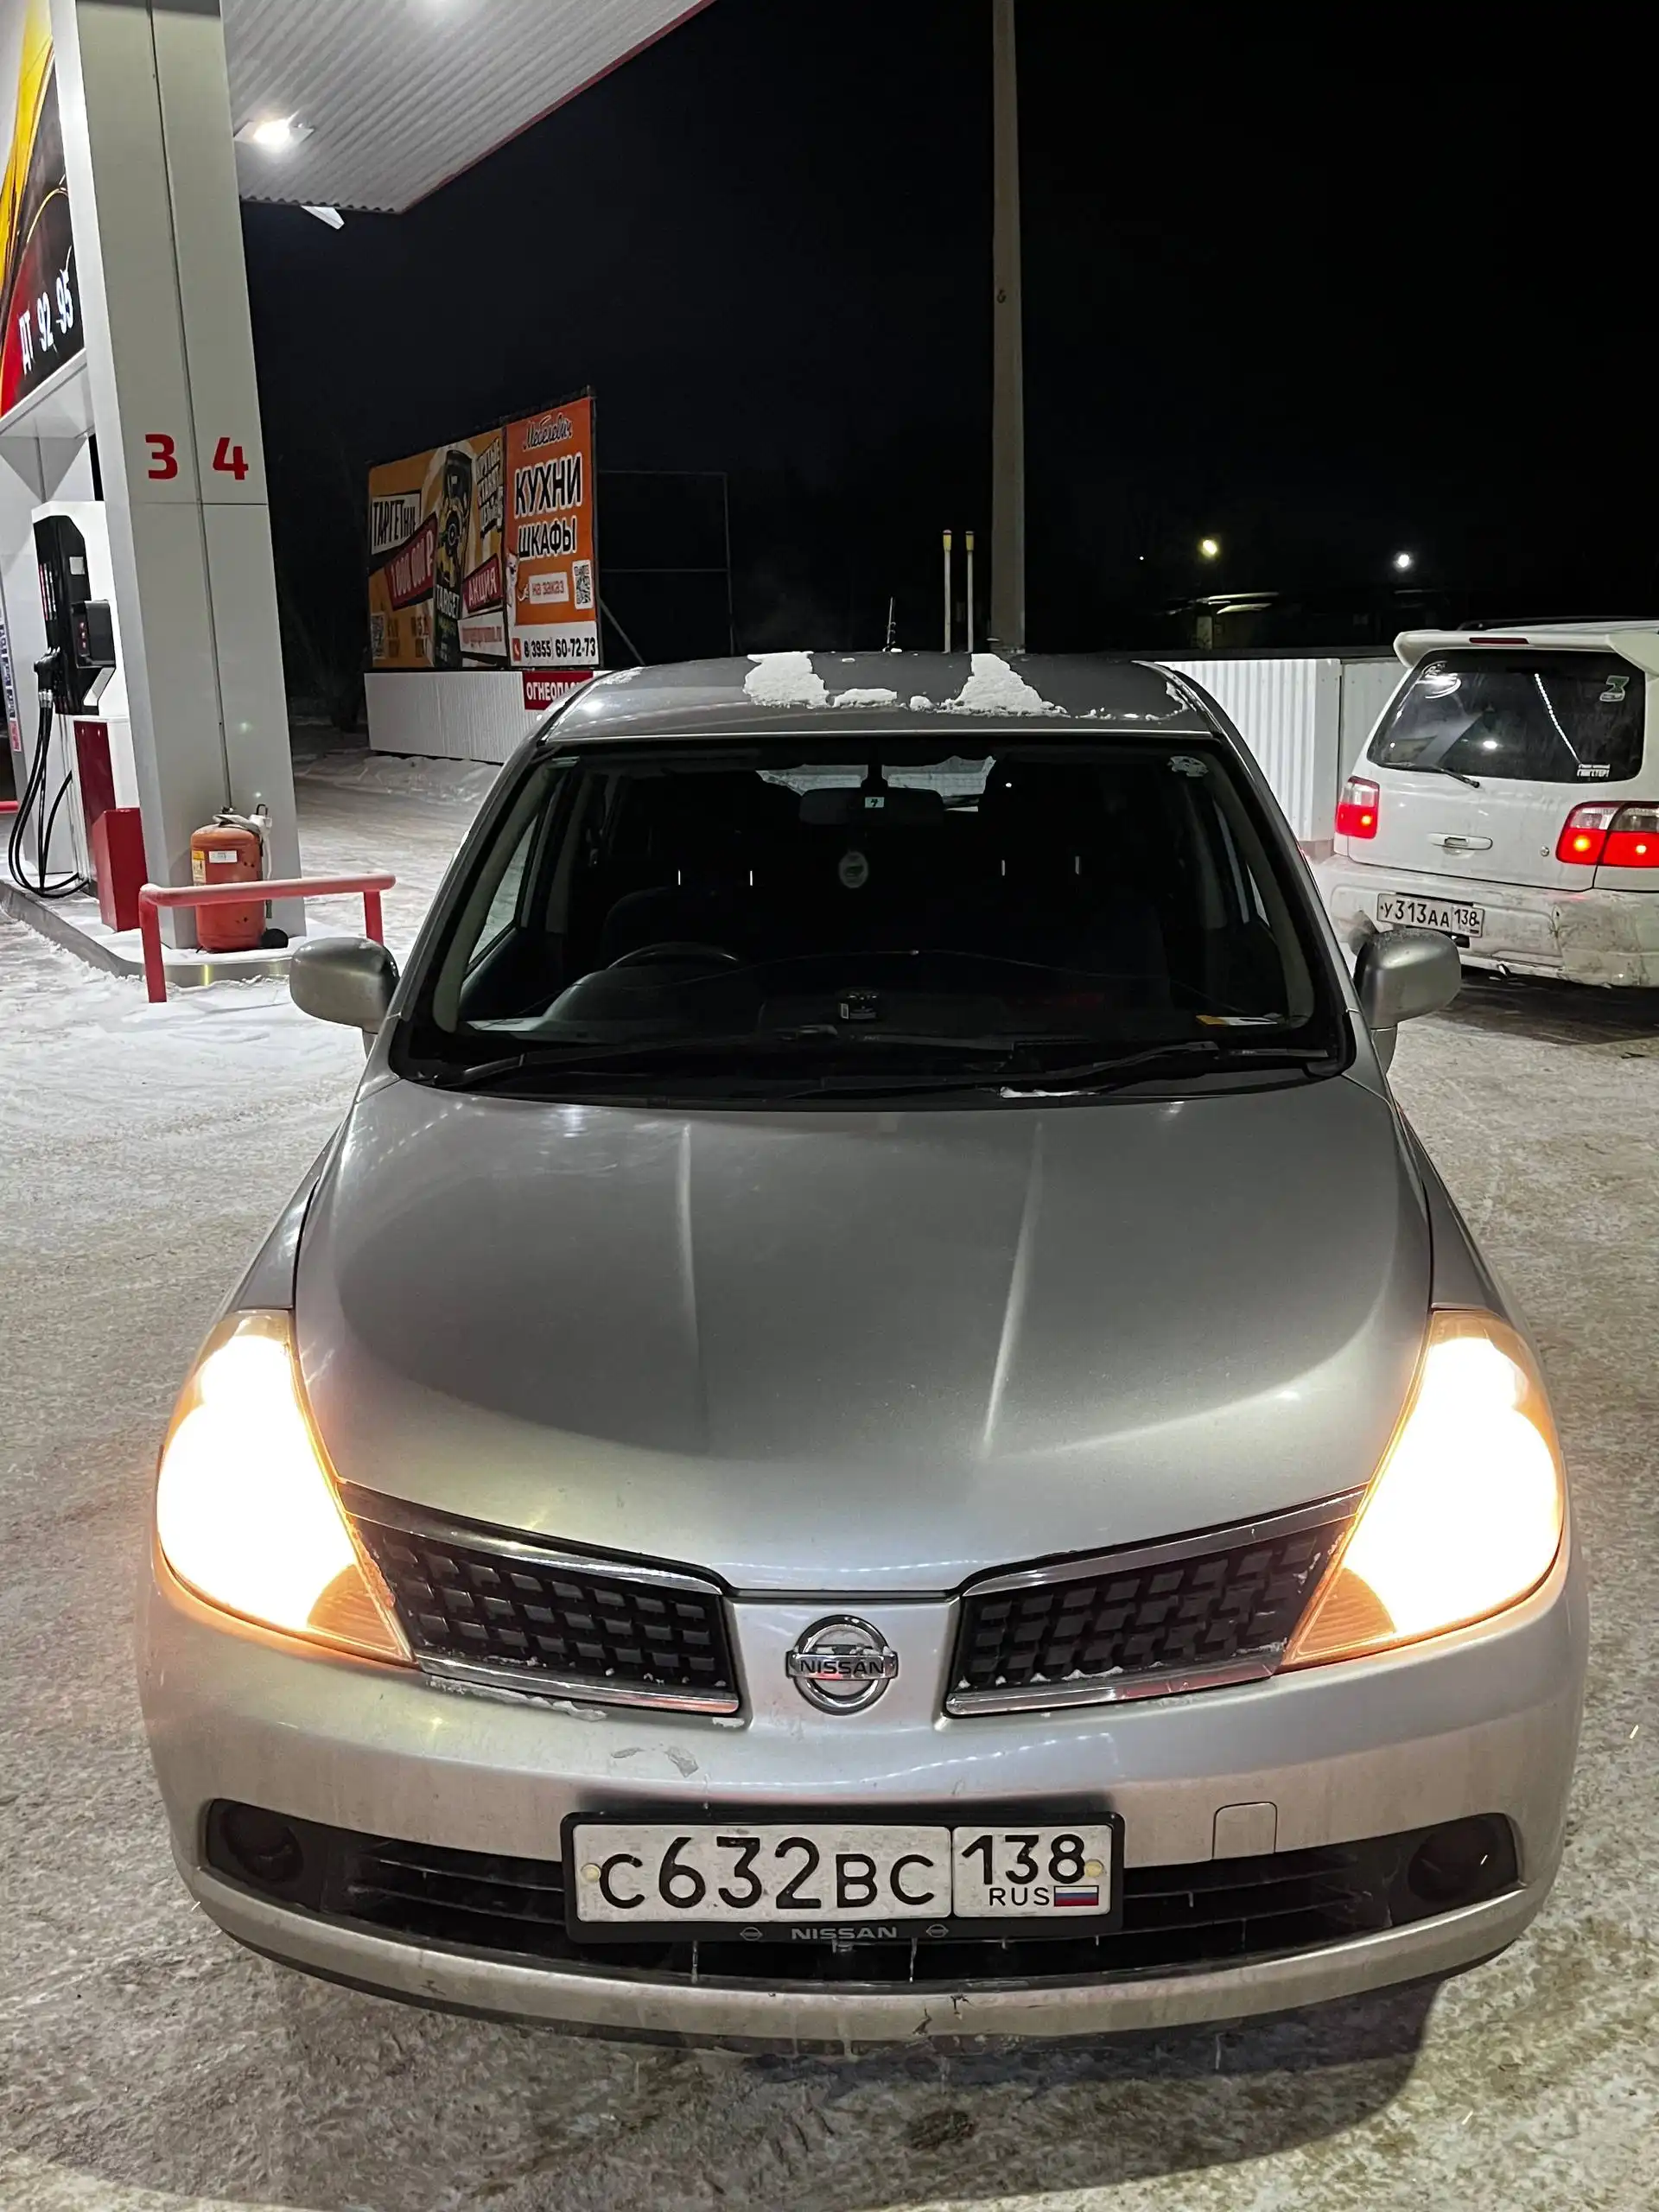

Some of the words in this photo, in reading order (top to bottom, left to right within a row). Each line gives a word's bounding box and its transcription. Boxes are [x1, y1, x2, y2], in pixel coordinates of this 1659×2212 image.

[18, 308, 34, 375] ДТ
[37, 291, 54, 352] 92
[56, 276, 73, 334] 95
[145, 434, 178, 480] 3
[213, 436, 249, 480] 4
[514, 453, 582, 518] КУХНИ
[518, 515, 577, 561] ШКАФЫ
[467, 567, 498, 607] АКЦИЯ
[555, 637, 596, 658] 60-72-73
[1384, 899, 1450, 928] У313АА
[1454, 908, 1478, 927] 138
[800, 1659, 885, 1675] NISSAN
[599, 1836, 936, 1910] С632ВС
[961, 1833, 1086, 1885] 138
[988, 1885, 1051, 1907] RUS
[791, 1925, 898, 1941] NISSAN
